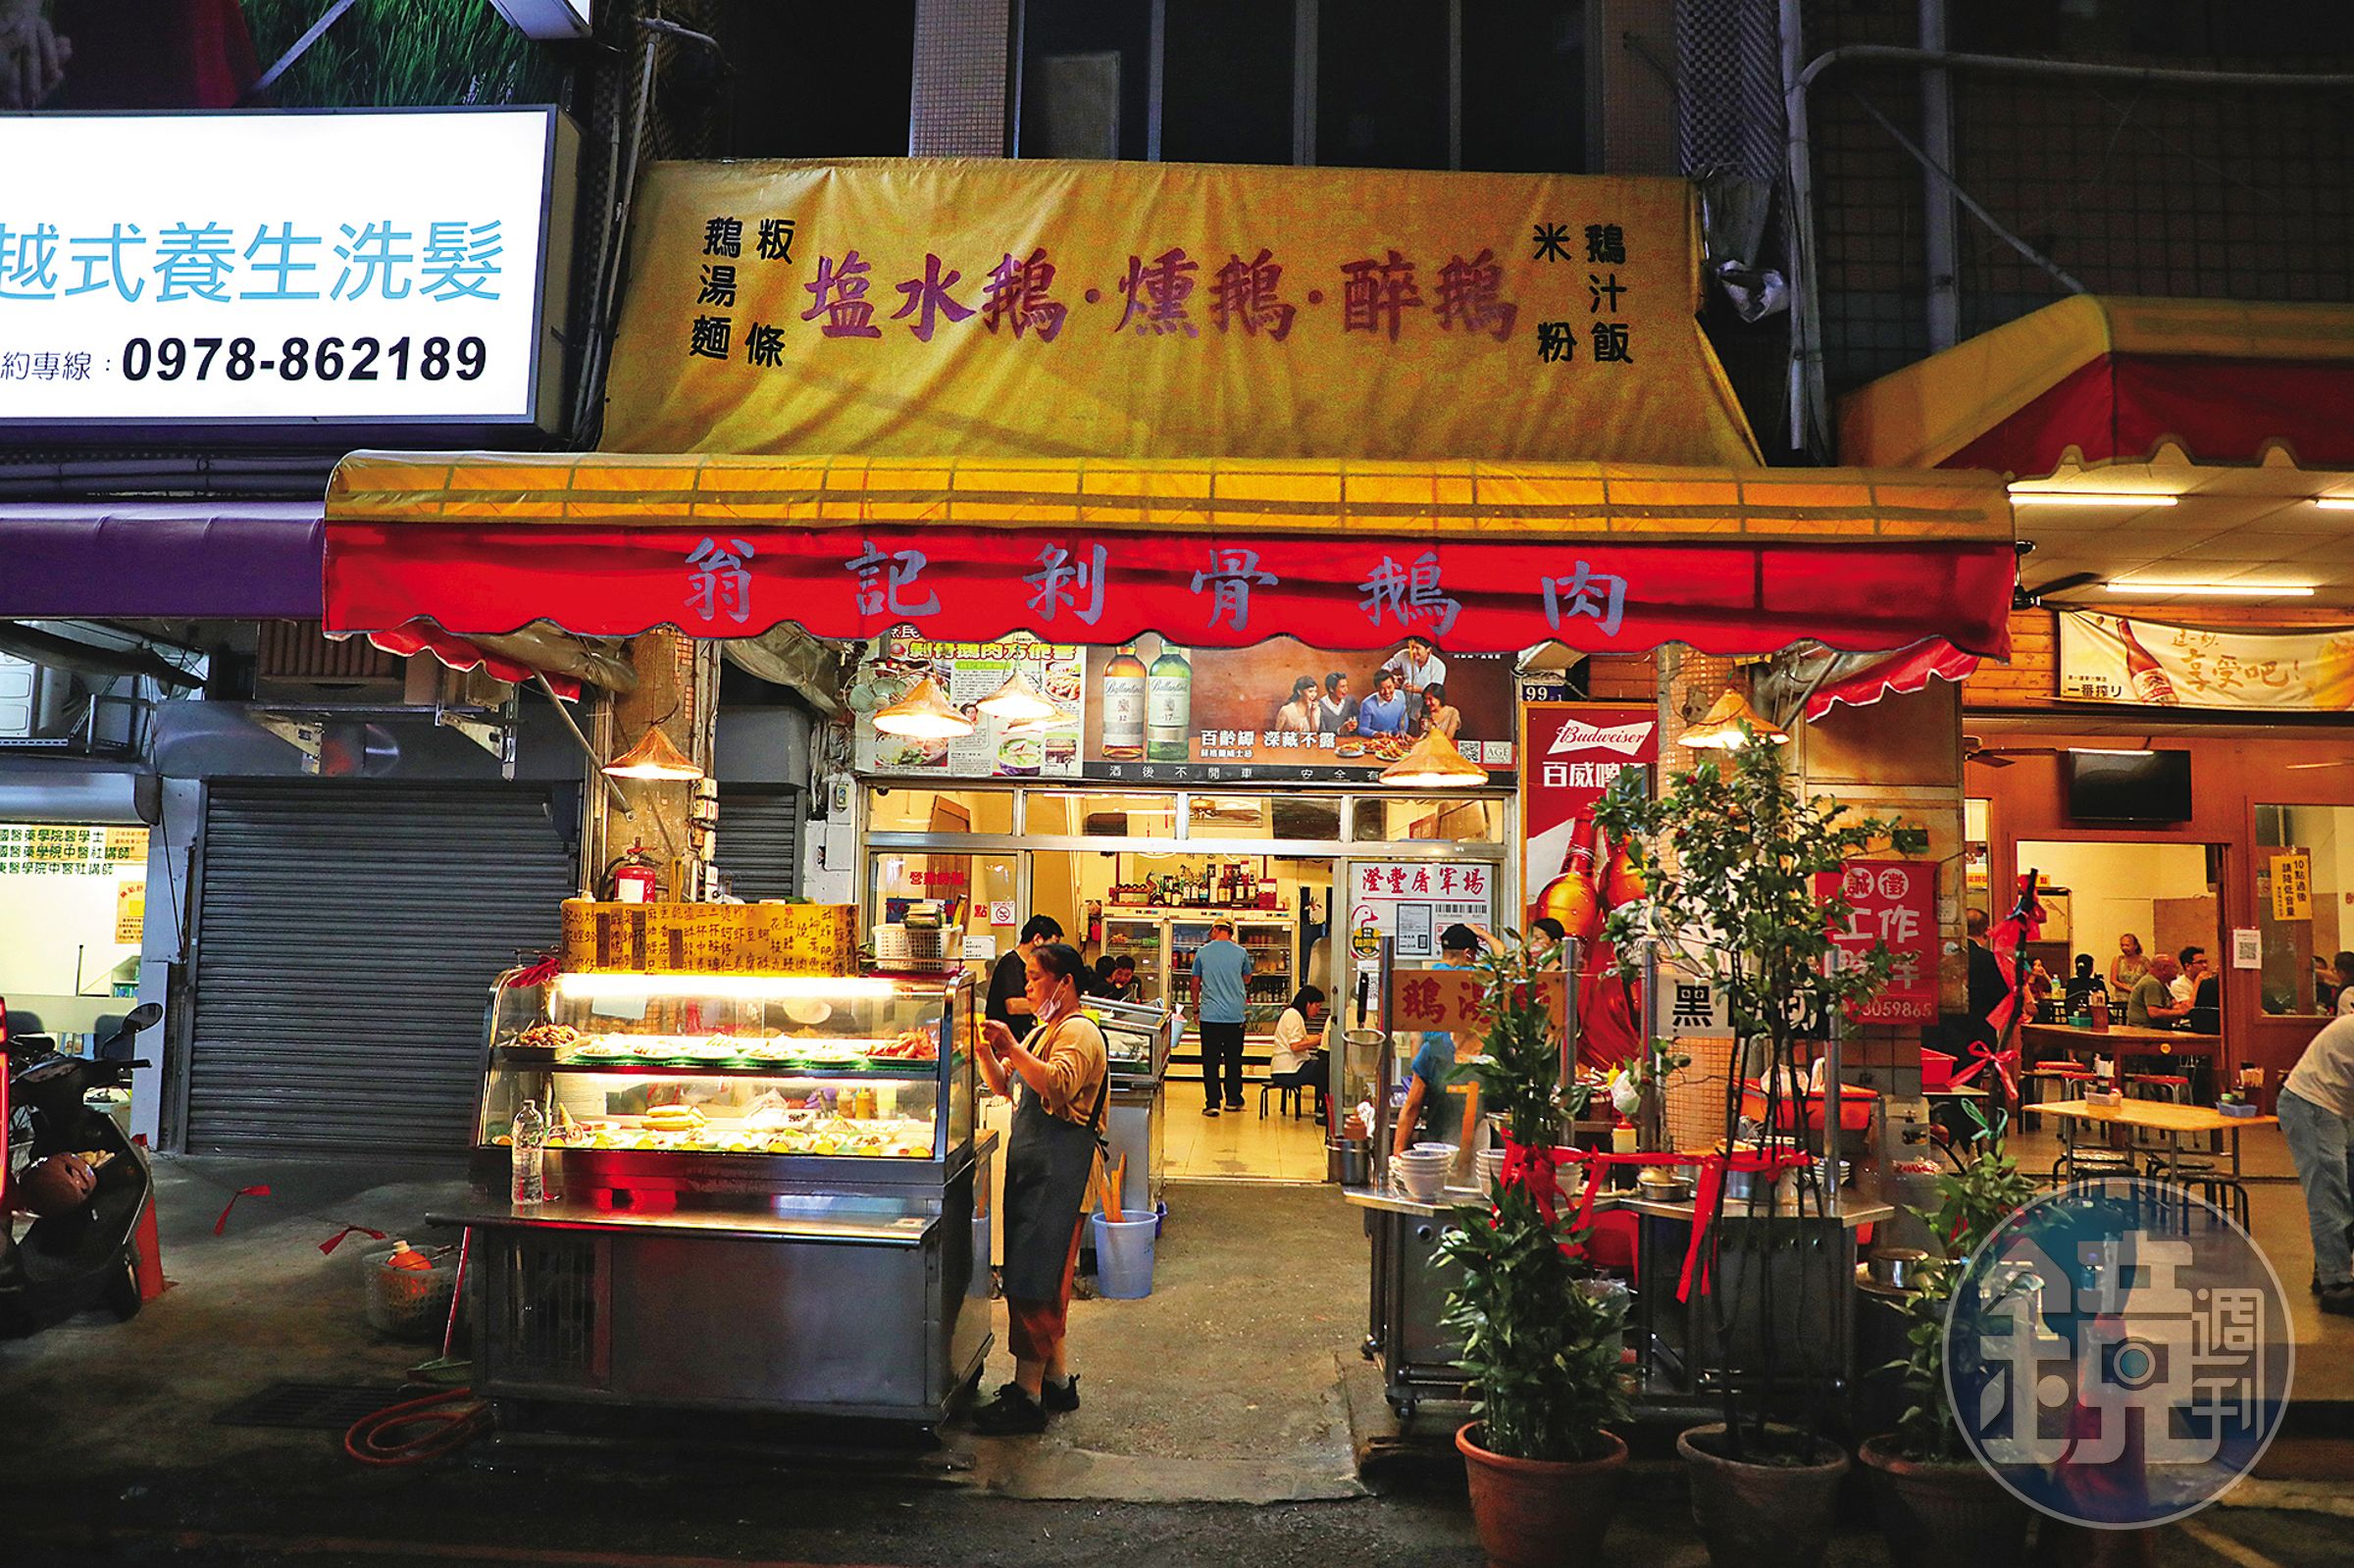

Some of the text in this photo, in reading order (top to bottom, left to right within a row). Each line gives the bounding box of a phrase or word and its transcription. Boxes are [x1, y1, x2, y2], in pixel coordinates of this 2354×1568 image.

[0, 219, 503, 304] 越式養生洗髮
[690, 216, 742, 361] 鵝湯麵
[1532, 222, 1577, 364] 米粉
[1584, 224, 1634, 364] 鵝汁飯
[121, 335, 487, 381] 0978-862189
[1525, 686, 1549, 701] 99
[1556, 725, 1646, 745] Budweiser
[1108, 765, 1254, 779] 酒後不開車
[1542, 760, 1647, 788] 百威啤
[1833, 904, 1920, 943] 工作
